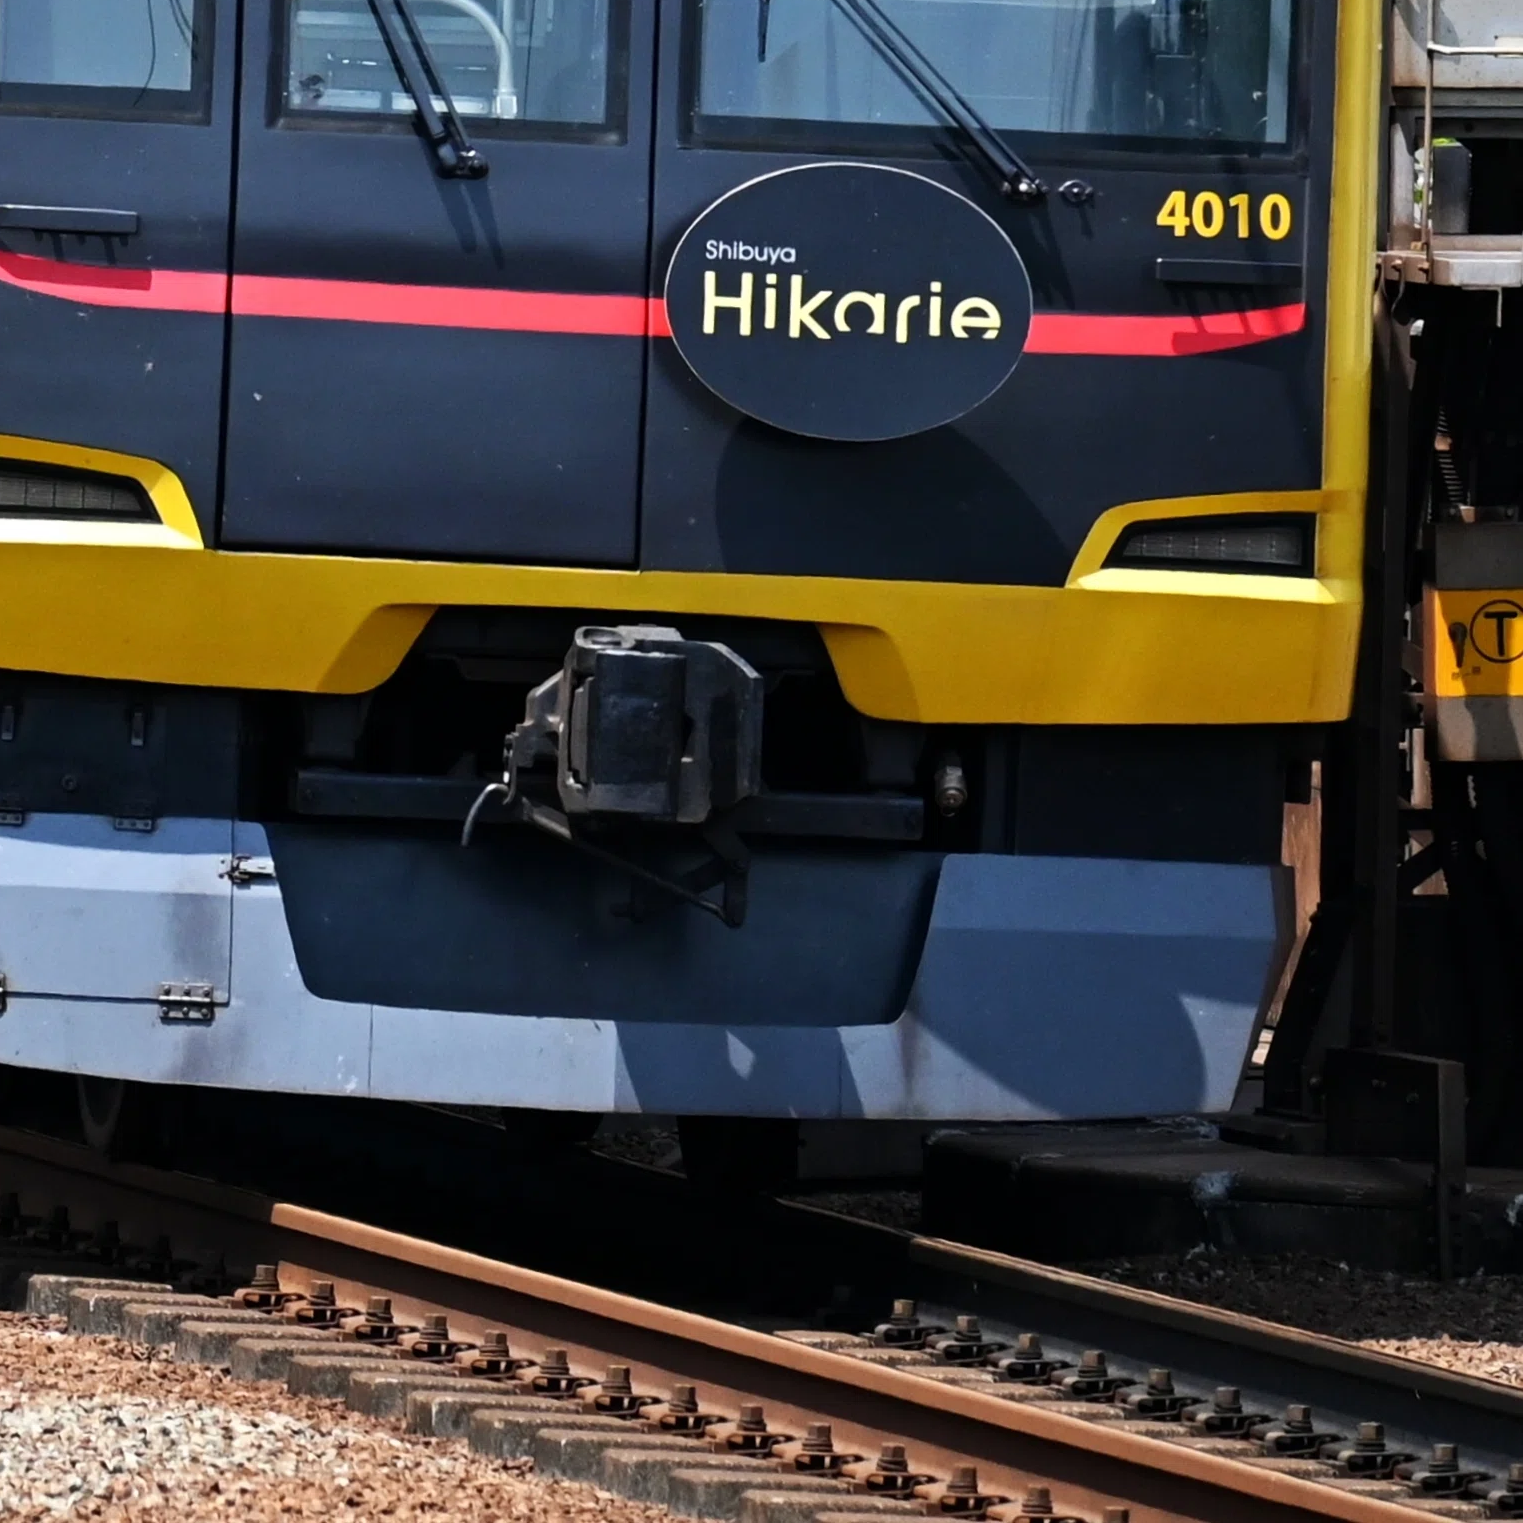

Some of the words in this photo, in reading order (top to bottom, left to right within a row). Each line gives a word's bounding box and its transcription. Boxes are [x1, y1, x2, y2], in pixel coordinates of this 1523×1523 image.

[1156, 190, 1291, 240] 4010
[705, 239, 797, 266] Shibuya
[702, 270, 1002, 344] Hikarie
